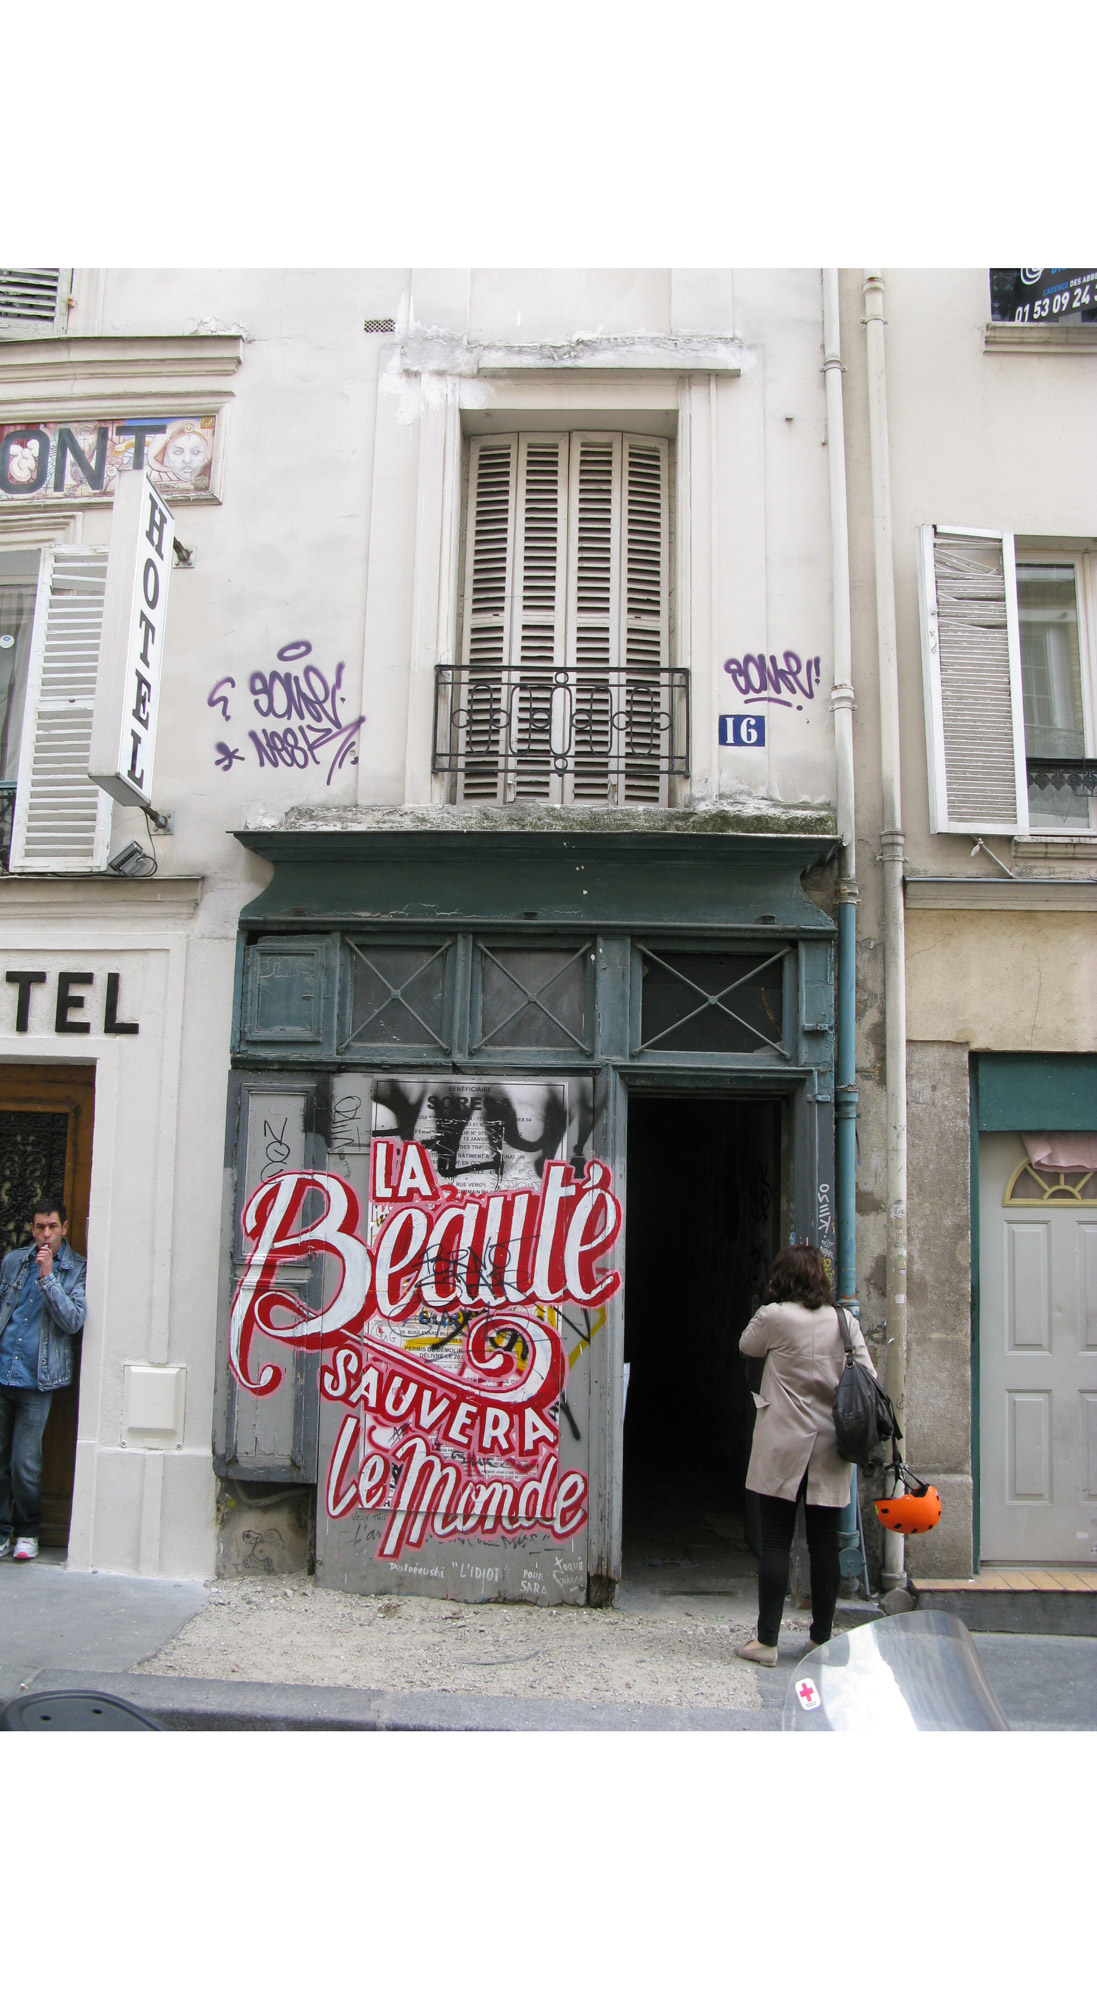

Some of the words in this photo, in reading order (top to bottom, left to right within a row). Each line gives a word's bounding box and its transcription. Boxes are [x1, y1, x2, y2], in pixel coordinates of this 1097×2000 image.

[1015, 304, 1031, 322] 01
[1033, 298, 1050, 319] 53
[1053, 292, 1070, 313] 09
[1073, 285, 1091, 308] 24
[1070, 277, 1082, 288] DES
[0, 424, 167, 494] ONT
[127, 492, 168, 790] HOTEL
[725, 717, 758, 744] 16
[6, 970, 139, 1034] TEL
[370, 1139, 440, 1203] LA
[229, 1160, 623, 1395] Beauté
[321, 1346, 560, 1458] SAUVERA
[325, 1413, 390, 1520] Le
[376, 1434, 589, 1559] Monde
[520, 1580, 547, 1595] SARA
[523, 1569, 544, 1581] POUR
